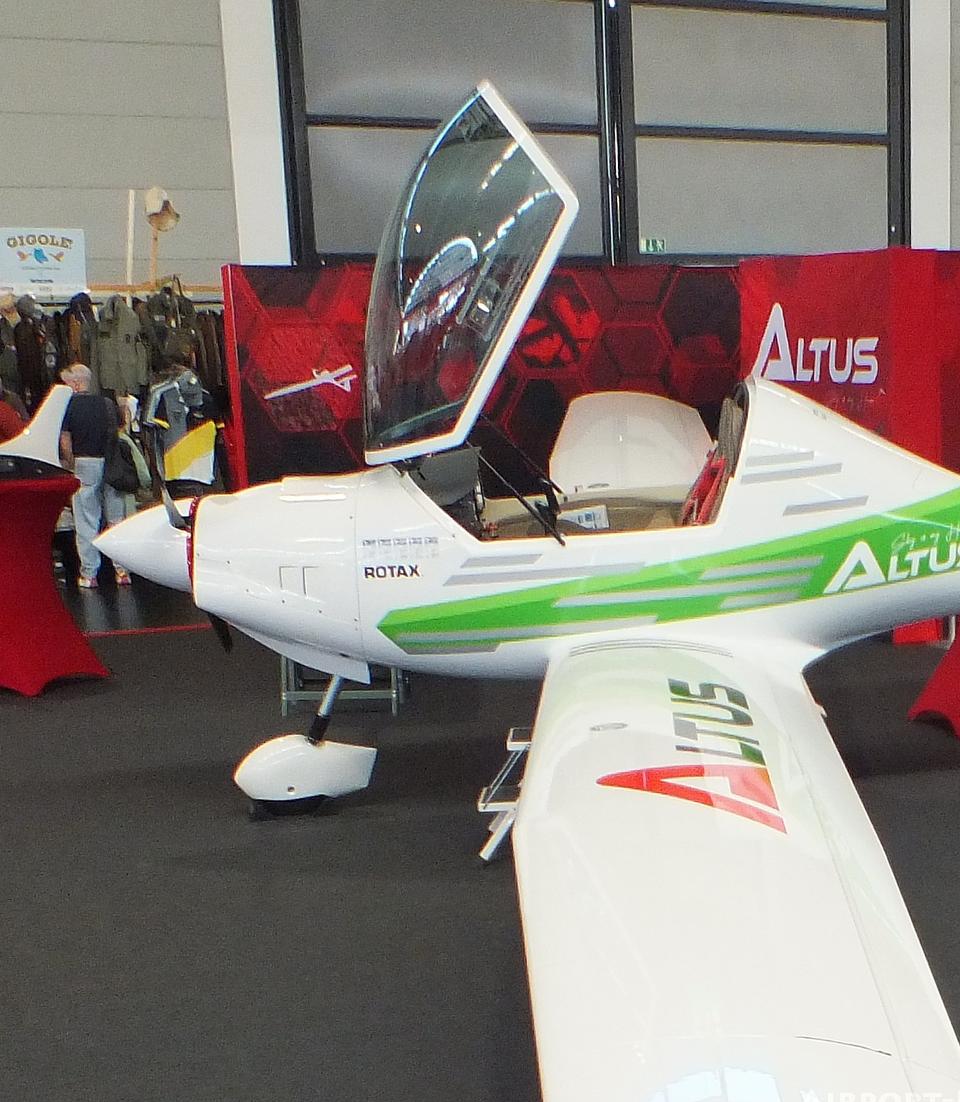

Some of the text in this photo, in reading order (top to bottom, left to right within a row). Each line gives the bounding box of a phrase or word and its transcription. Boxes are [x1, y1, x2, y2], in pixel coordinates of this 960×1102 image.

[752, 302, 879, 385] ALTUS
[363, 565, 421, 579] ROTAX
[596, 678, 788, 834] ALTUS
